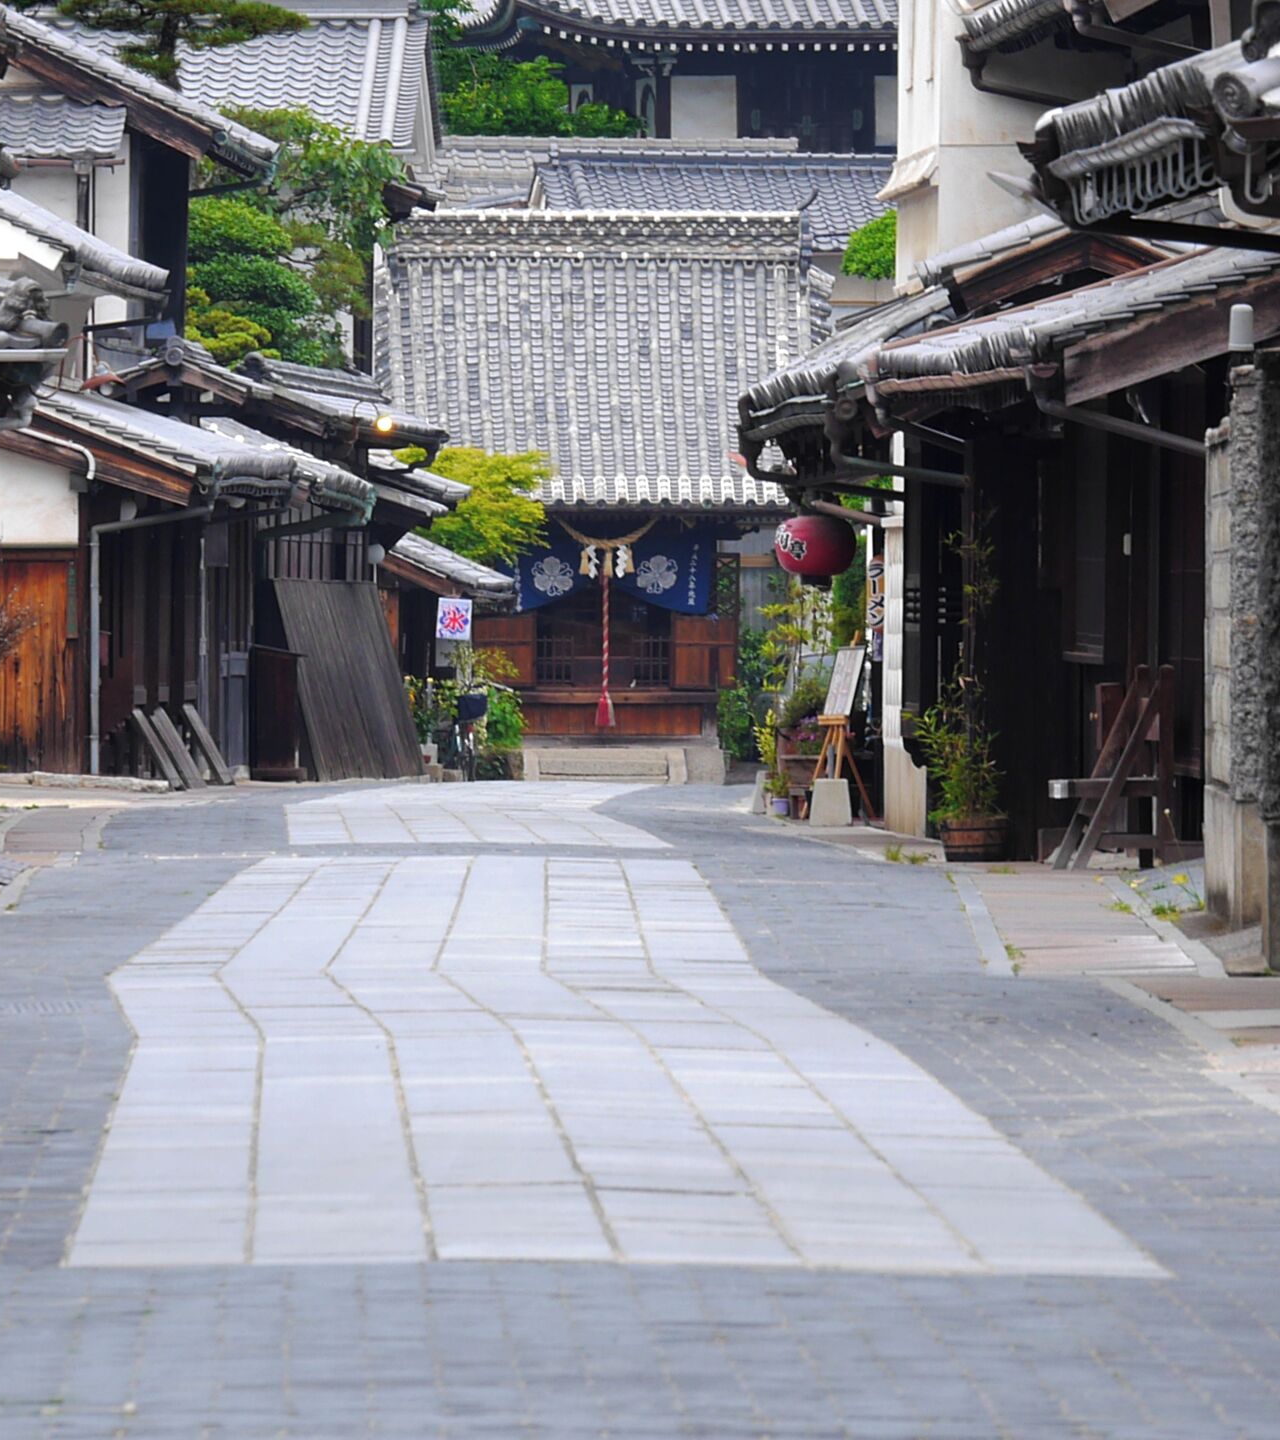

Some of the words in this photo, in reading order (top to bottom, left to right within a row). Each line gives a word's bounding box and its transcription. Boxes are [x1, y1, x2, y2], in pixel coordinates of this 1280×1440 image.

[868, 563, 885, 627] ラーメン
[444, 609, 465, 631] 氷
